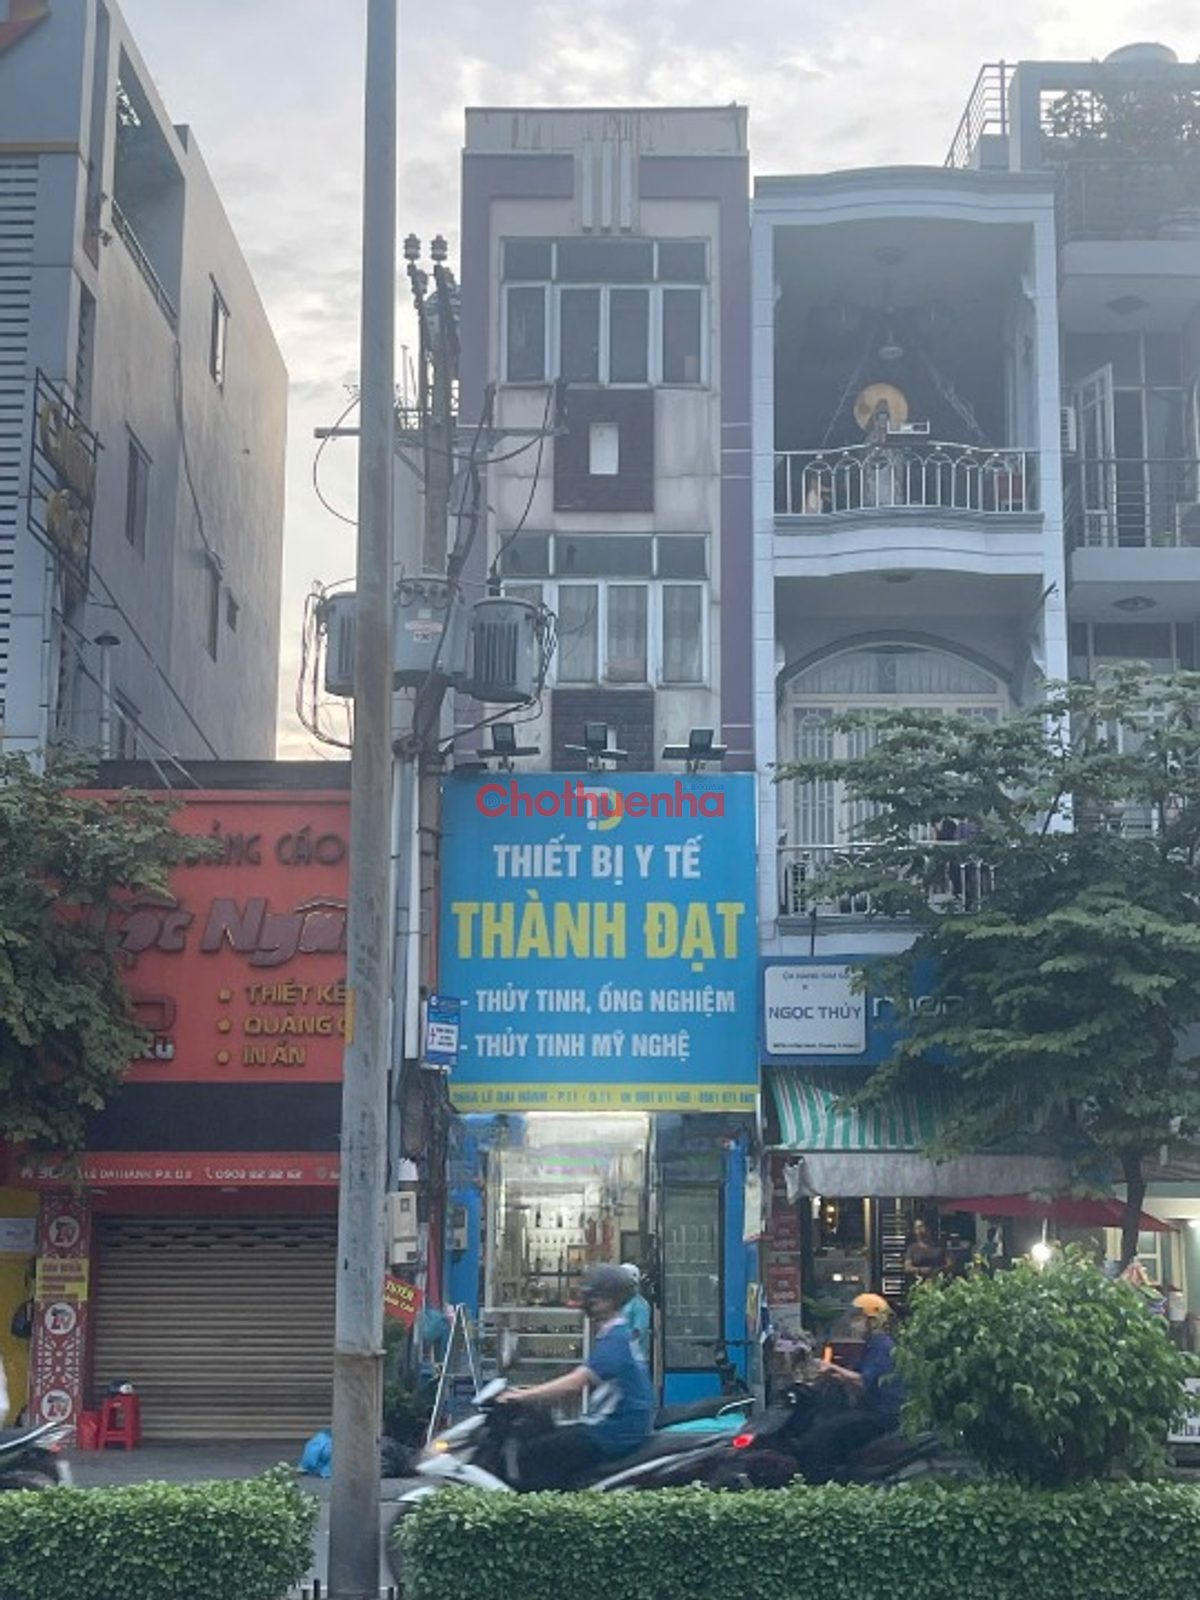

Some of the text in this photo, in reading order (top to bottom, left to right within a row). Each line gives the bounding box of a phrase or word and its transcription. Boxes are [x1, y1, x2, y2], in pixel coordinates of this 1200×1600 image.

[493, 834, 702, 885] THIẾT BỊ Y TẾ
[451, 889, 745, 972] THÀNH ĐẠT
[247, 978, 313, 1004] THIẾT
[475, 982, 529, 1012] THỦY
[536, 988, 591, 1015] TINH,
[597, 981, 643, 1012] ỐNG
[650, 985, 735, 1017] NGHIỆM
[244, 1011, 333, 1035] QUẢNG
[769, 1006, 814, 1021] NGỌC
[818, 1002, 862, 1019] THỦY
[243, 1040, 306, 1066] IN ẤN
[475, 1026, 529, 1057] THỦY
[536, 1033, 585, 1057] TINH
[591, 1029, 625, 1057] MỸ
[631, 1029, 690, 1062] NGHỆ
